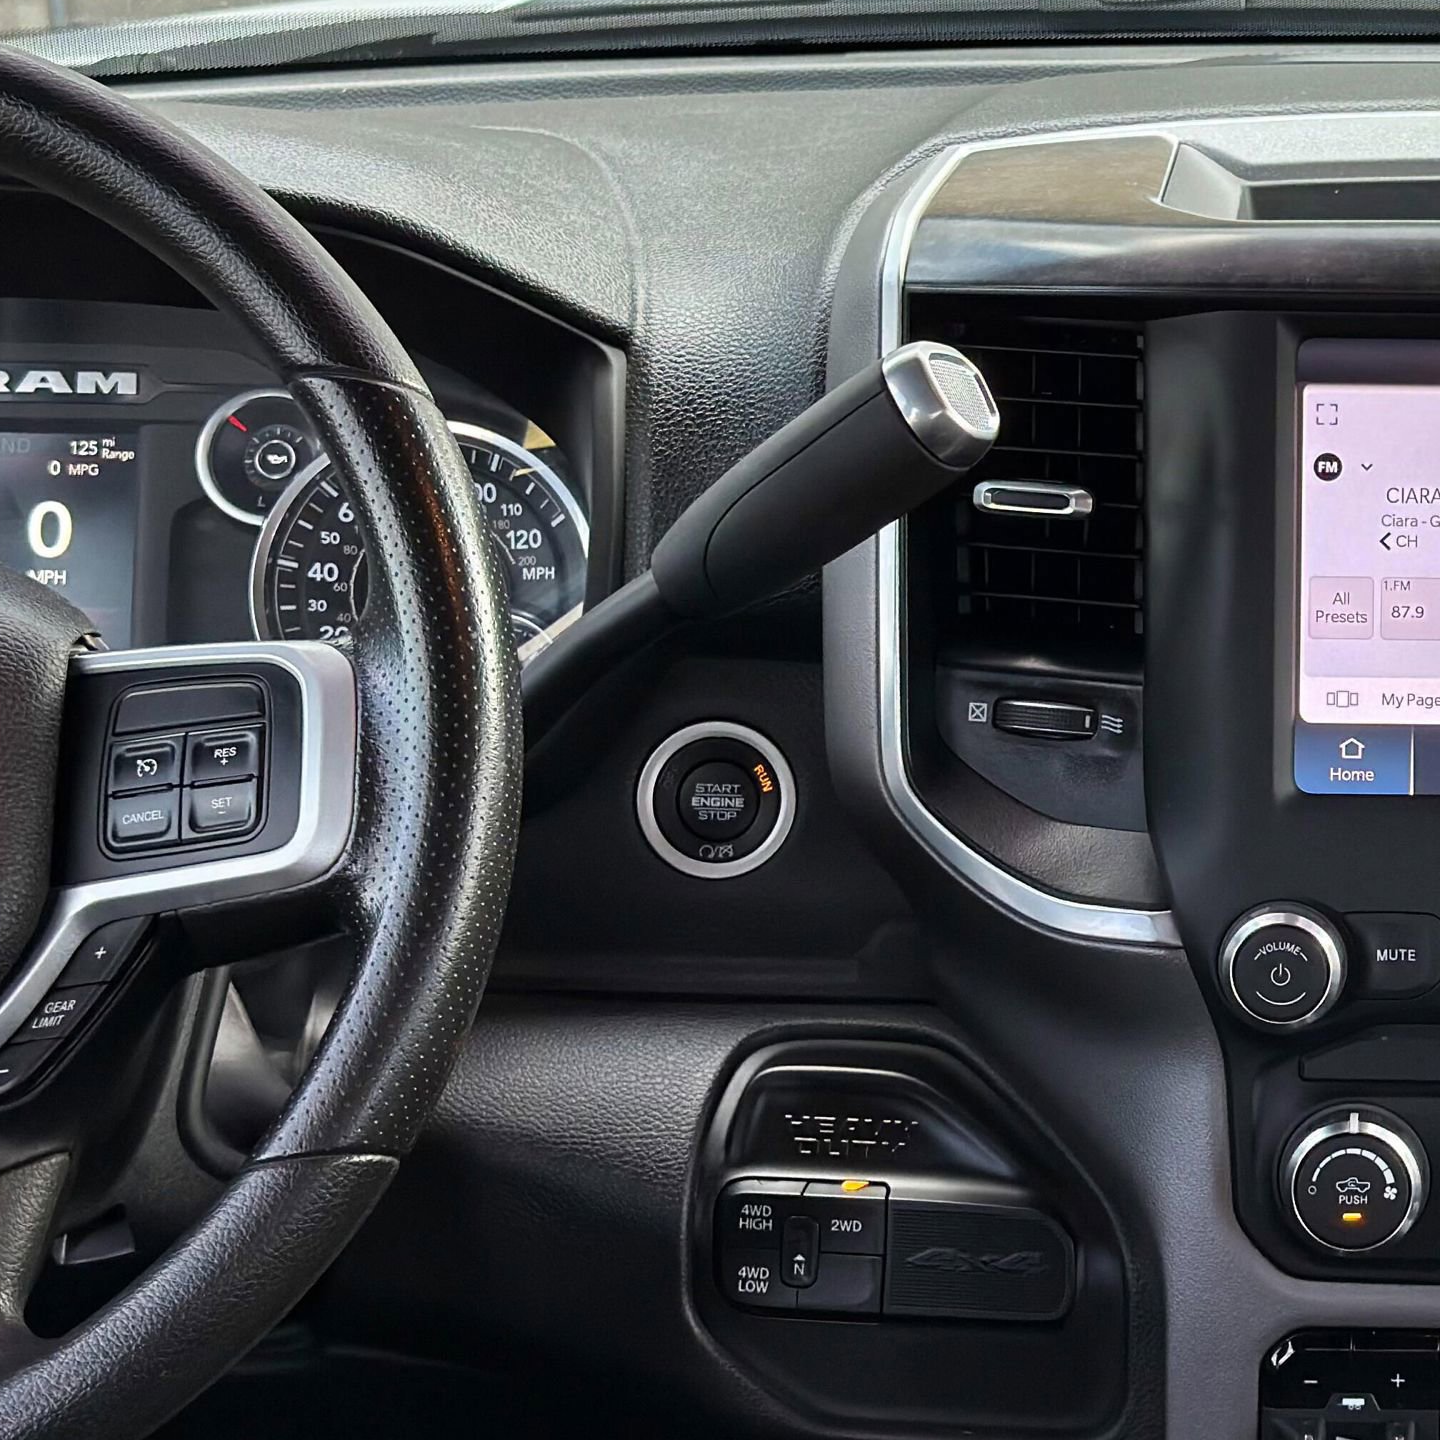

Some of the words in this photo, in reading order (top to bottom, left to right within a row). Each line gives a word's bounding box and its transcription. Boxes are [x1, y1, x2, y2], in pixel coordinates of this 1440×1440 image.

[70, 441, 98, 456] 125
[102, 437, 115, 448] mi
[102, 449, 135, 462] Range
[48, 461, 61, 476] 0
[69, 464, 100, 477] MPG
[1317, 461, 1338, 473] FM
[500, 503, 523, 517] 110
[1381, 514, 1418, 528] Ciara
[27, 500, 73, 559] 0
[320, 530, 340, 545] 50
[509, 529, 542, 550] 120
[1395, 535, 1418, 548] CH
[343, 544, 358, 556] 80
[517, 556, 537, 566] 200
[307, 563, 339, 582] 40
[522, 567, 555, 581] MPH
[333, 581, 348, 593] 60
[1383, 580, 1411, 592] 1.FM
[308, 599, 328, 612] 30
[1332, 592, 1351, 606] All
[1315, 610, 1368, 624] Presets
[1391, 606, 1424, 619] 87.9
[1381, 693, 1404, 708] My
[214, 747, 237, 759] RES
[753, 763, 774, 793] RUN
[1330, 768, 1375, 782] Home
[695, 783, 741, 794] START
[211, 796, 233, 809] SET
[691, 796, 745, 808] ENGINE
[122, 810, 164, 825] CANCEL
[698, 810, 738, 821] STOP
[1259, 941, 1302, 956] VOLUME
[1376, 949, 1417, 962] MUTE
[44, 999, 76, 1014] GEAR
[32, 1014, 64, 1029] LIMIT
[1338, 1194, 1368, 1205] PUSH
[741, 1204, 772, 1217] 4WD
[739, 1218, 773, 1231] HIGH
[831, 1219, 862, 1232] 2WD
[738, 1266, 770, 1280] 4WD
[793, 1262, 805, 1276] N
[738, 1280, 769, 1294] LOW
